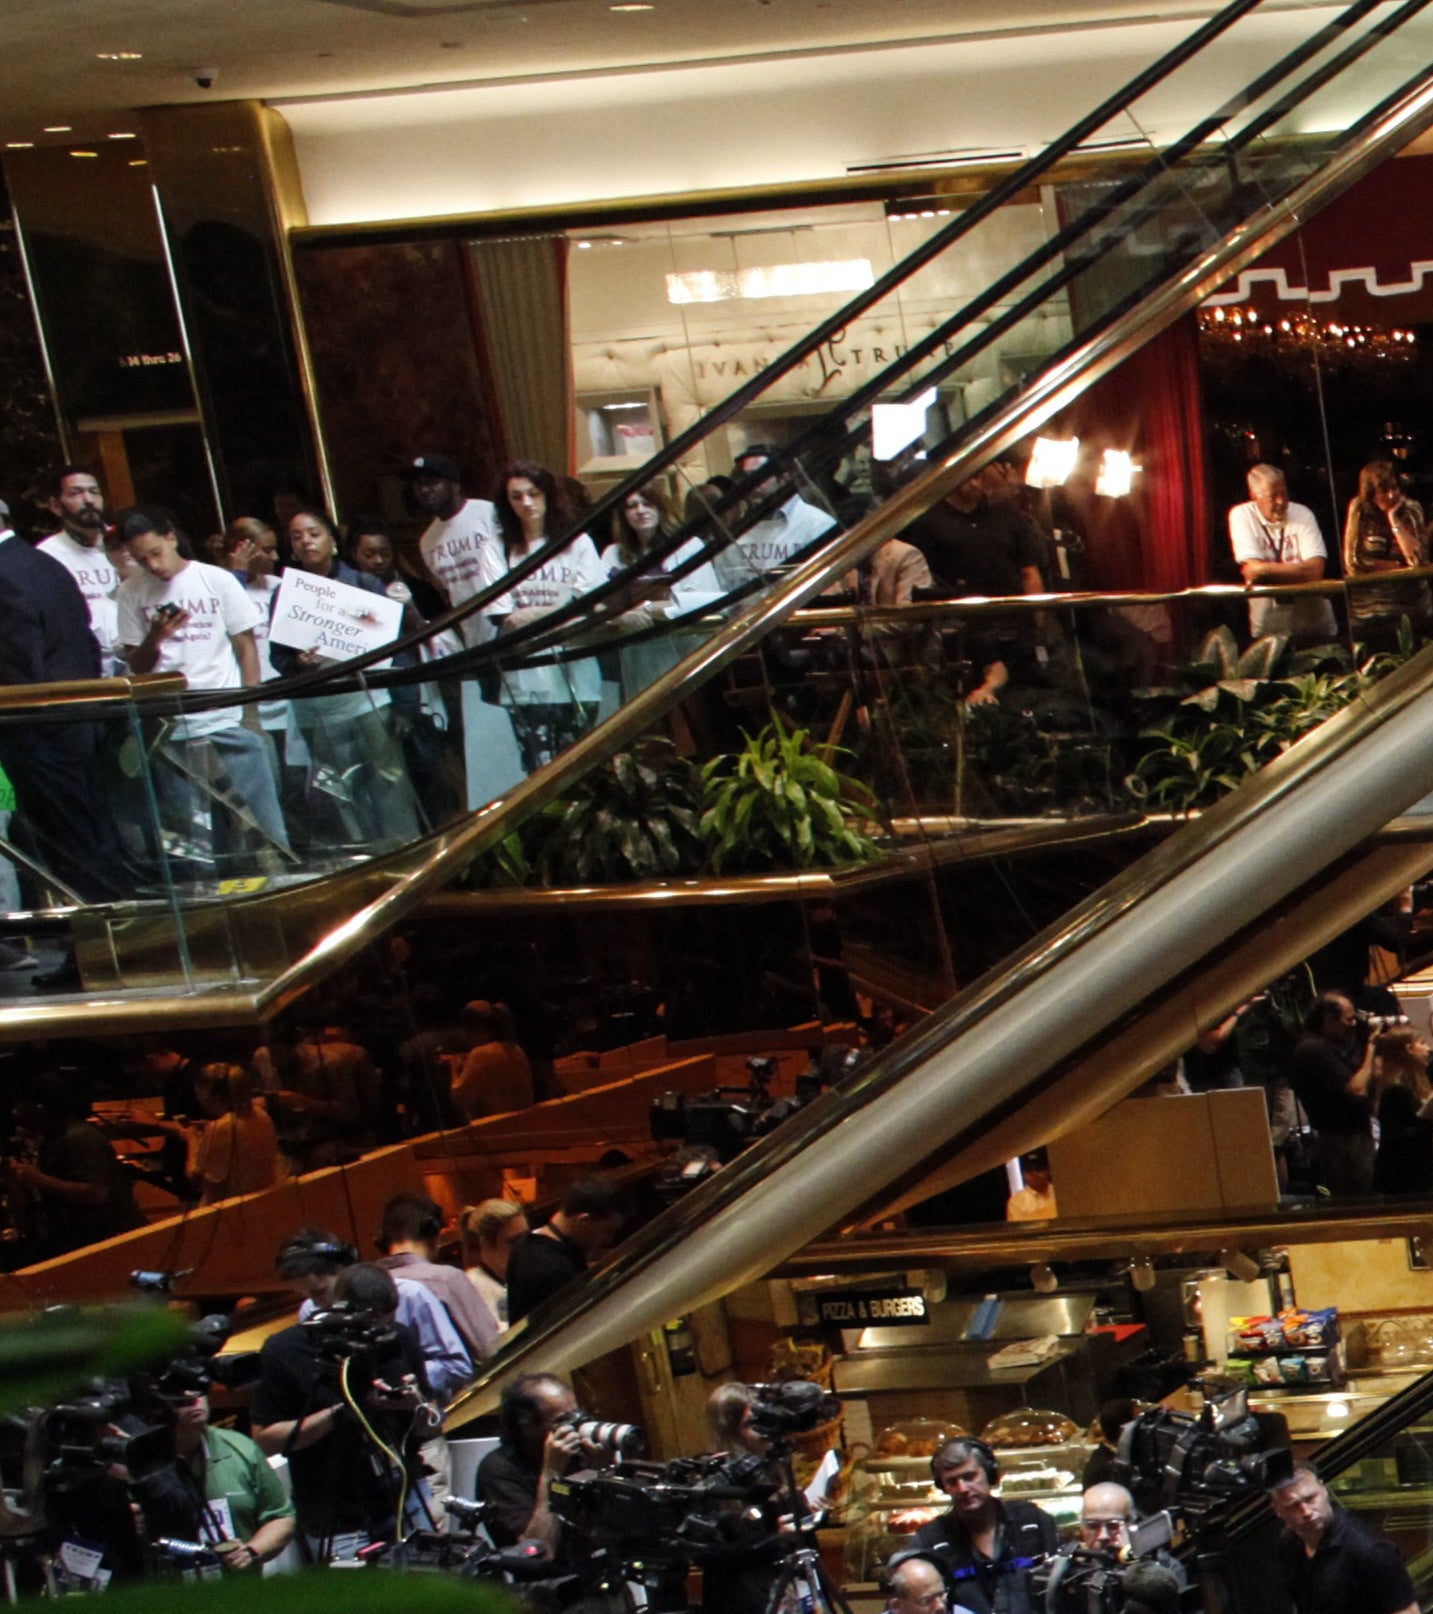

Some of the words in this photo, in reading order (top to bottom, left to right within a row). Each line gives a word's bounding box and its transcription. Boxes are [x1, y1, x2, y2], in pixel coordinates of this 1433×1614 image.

[295, 576, 337, 599] People
[314, 598, 337, 614] for
[337, 607, 346, 617] a
[287, 604, 364, 637] Stronger
[314, 631, 368, 655] Ameri
[822, 1301, 856, 1320] PIZZA
[869, 1296, 926, 1318] BURGERS
